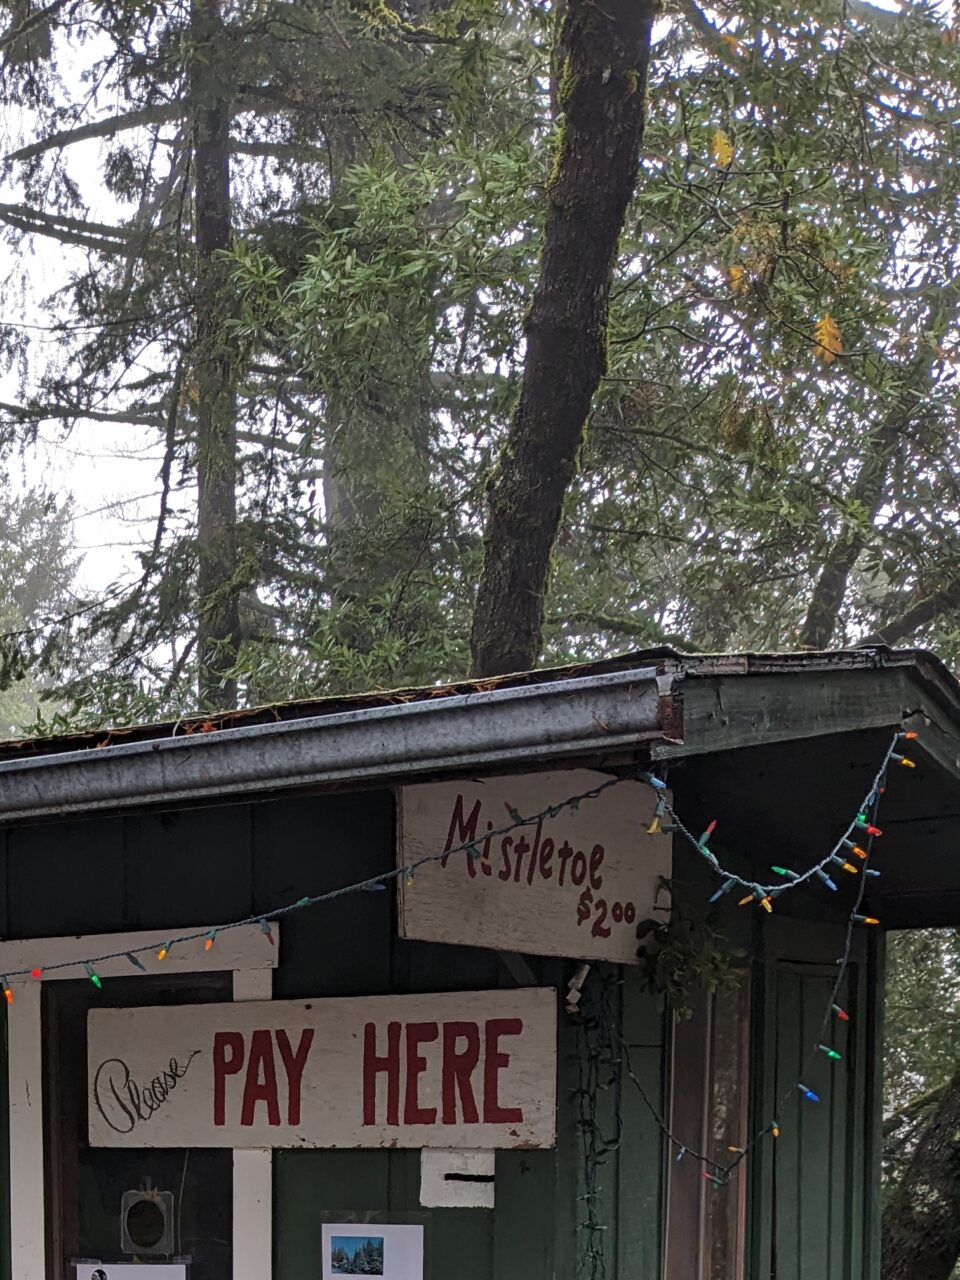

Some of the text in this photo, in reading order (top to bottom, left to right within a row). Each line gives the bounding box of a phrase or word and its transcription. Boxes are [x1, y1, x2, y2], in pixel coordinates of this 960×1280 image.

[441, 794, 605, 890] Mistletoe
[94, 1018, 524, 1134] Please PAY HERE
